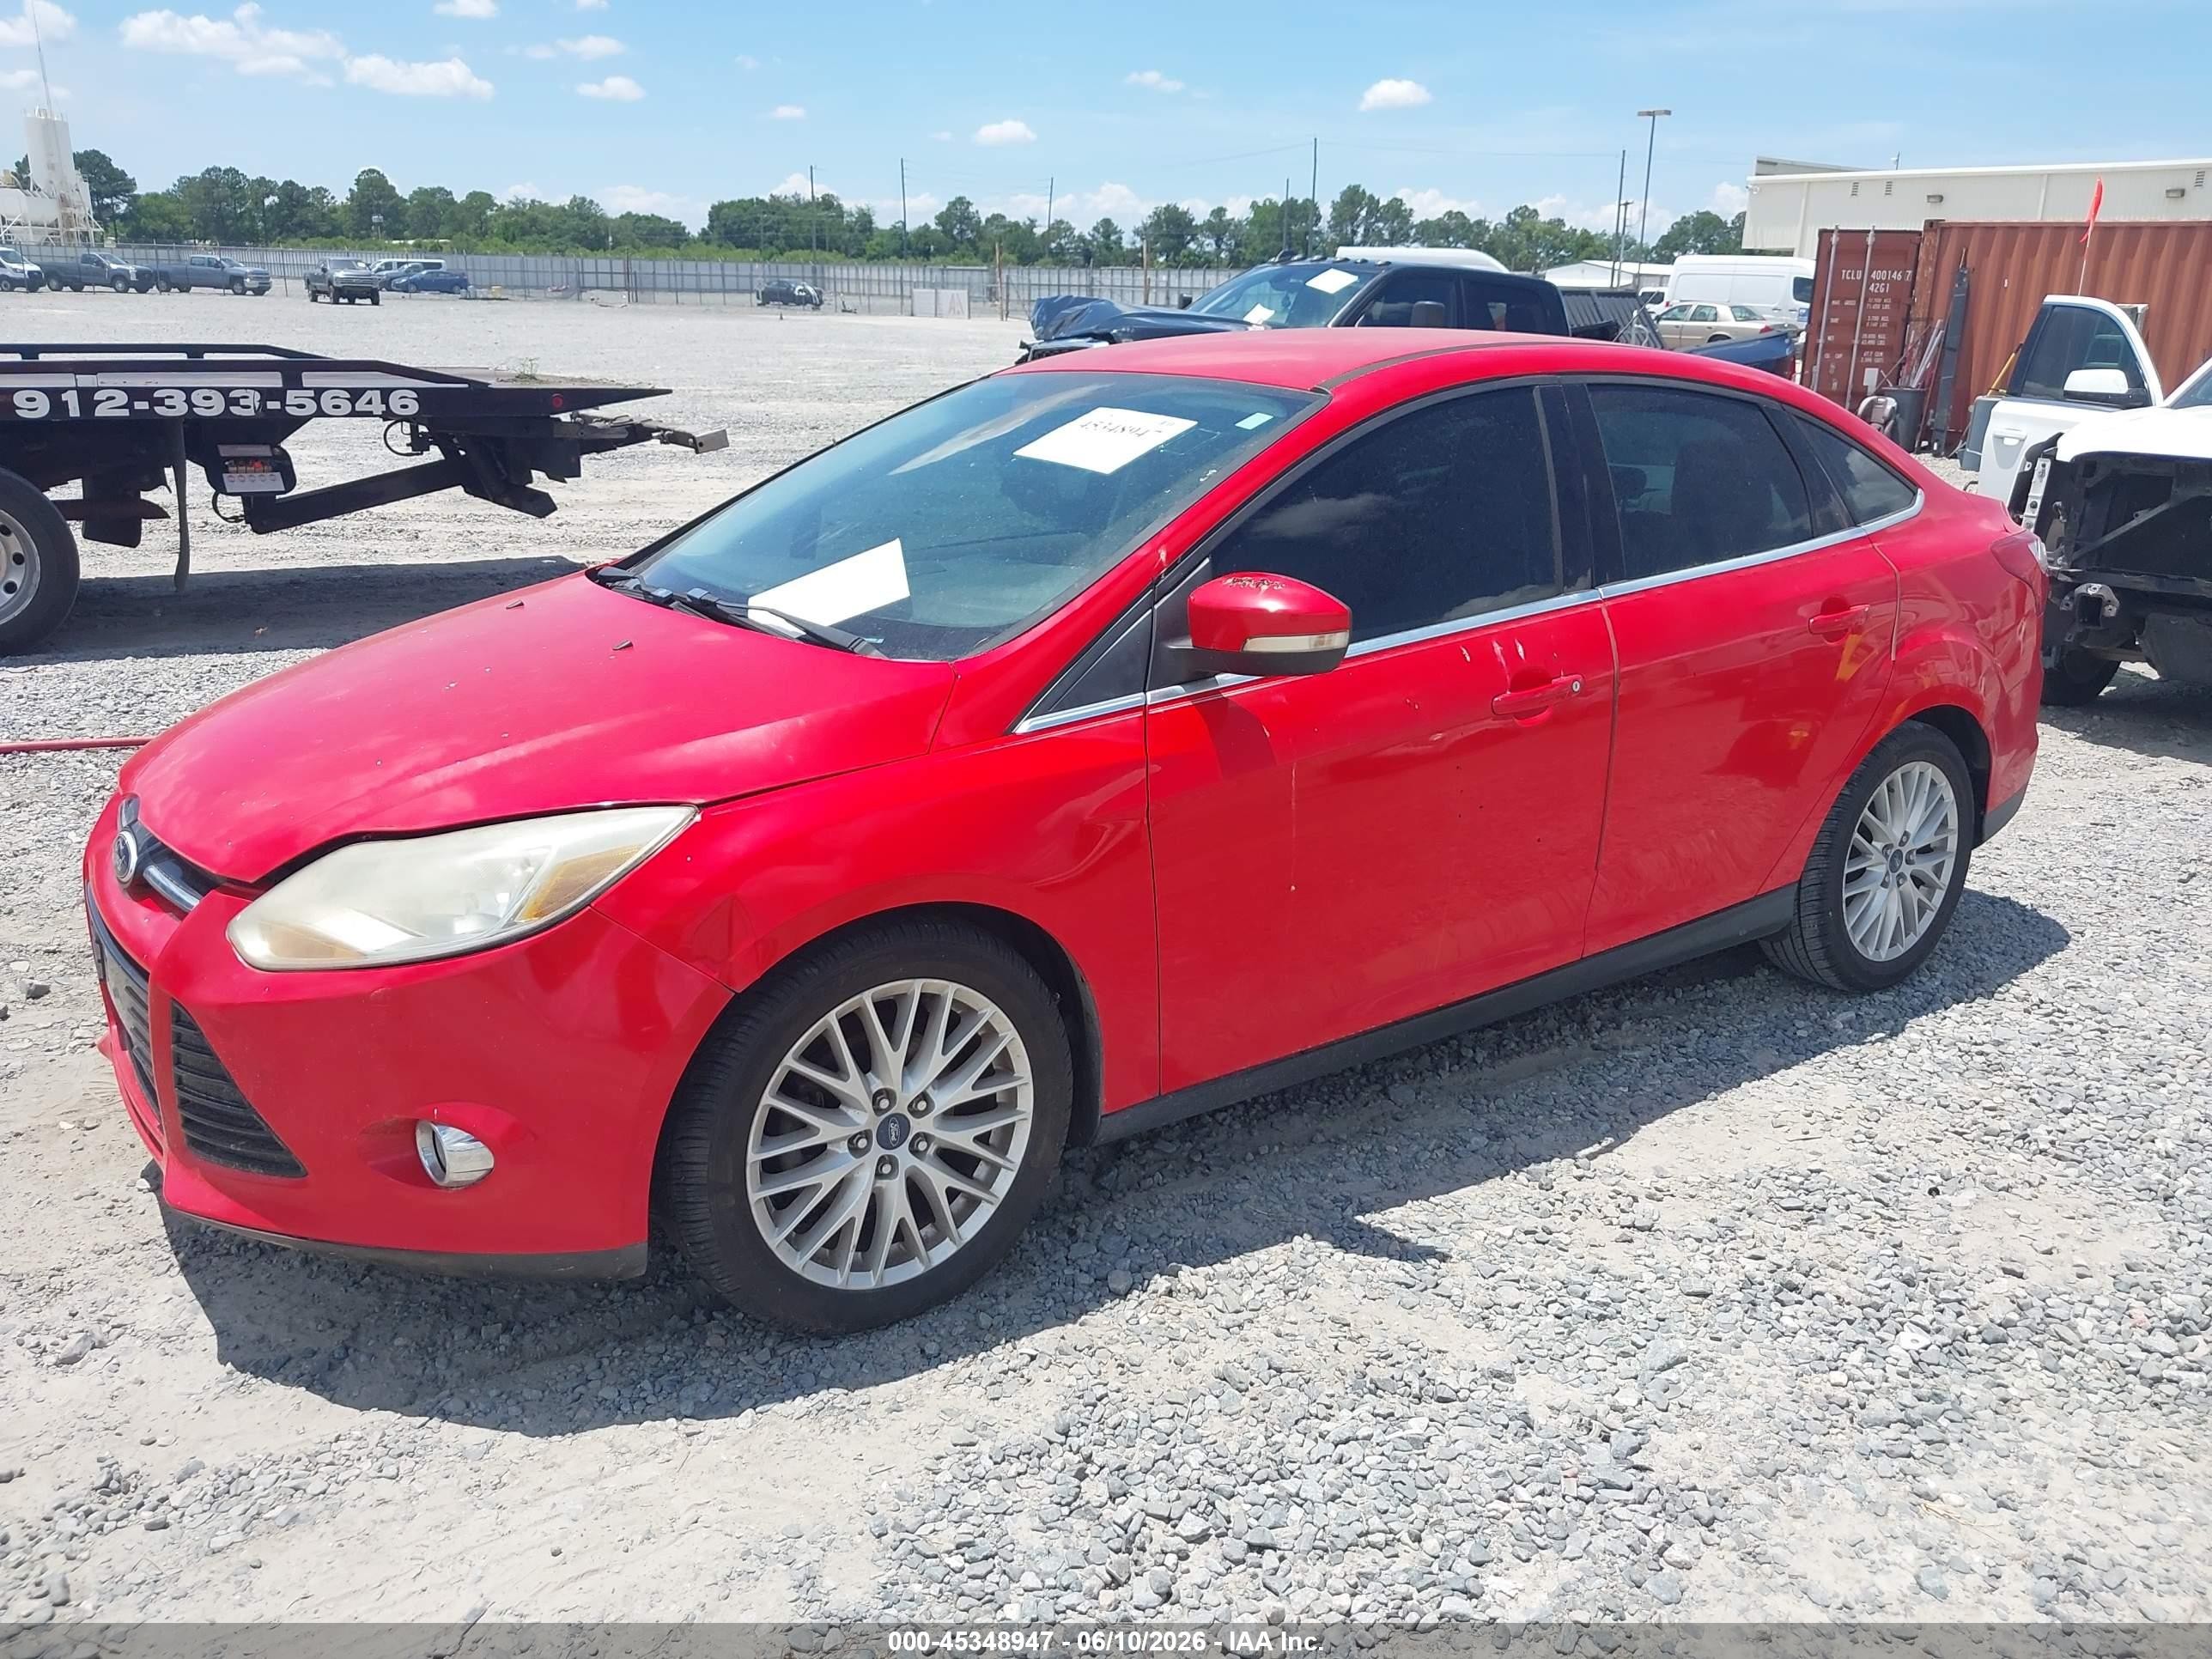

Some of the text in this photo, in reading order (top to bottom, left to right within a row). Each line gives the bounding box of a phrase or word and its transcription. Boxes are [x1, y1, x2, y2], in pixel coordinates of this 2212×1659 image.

[1841, 269, 1863, 280] TCLU
[1869, 283, 1890, 293] 42G1
[12, 389, 420, 418] 912-393-5646
